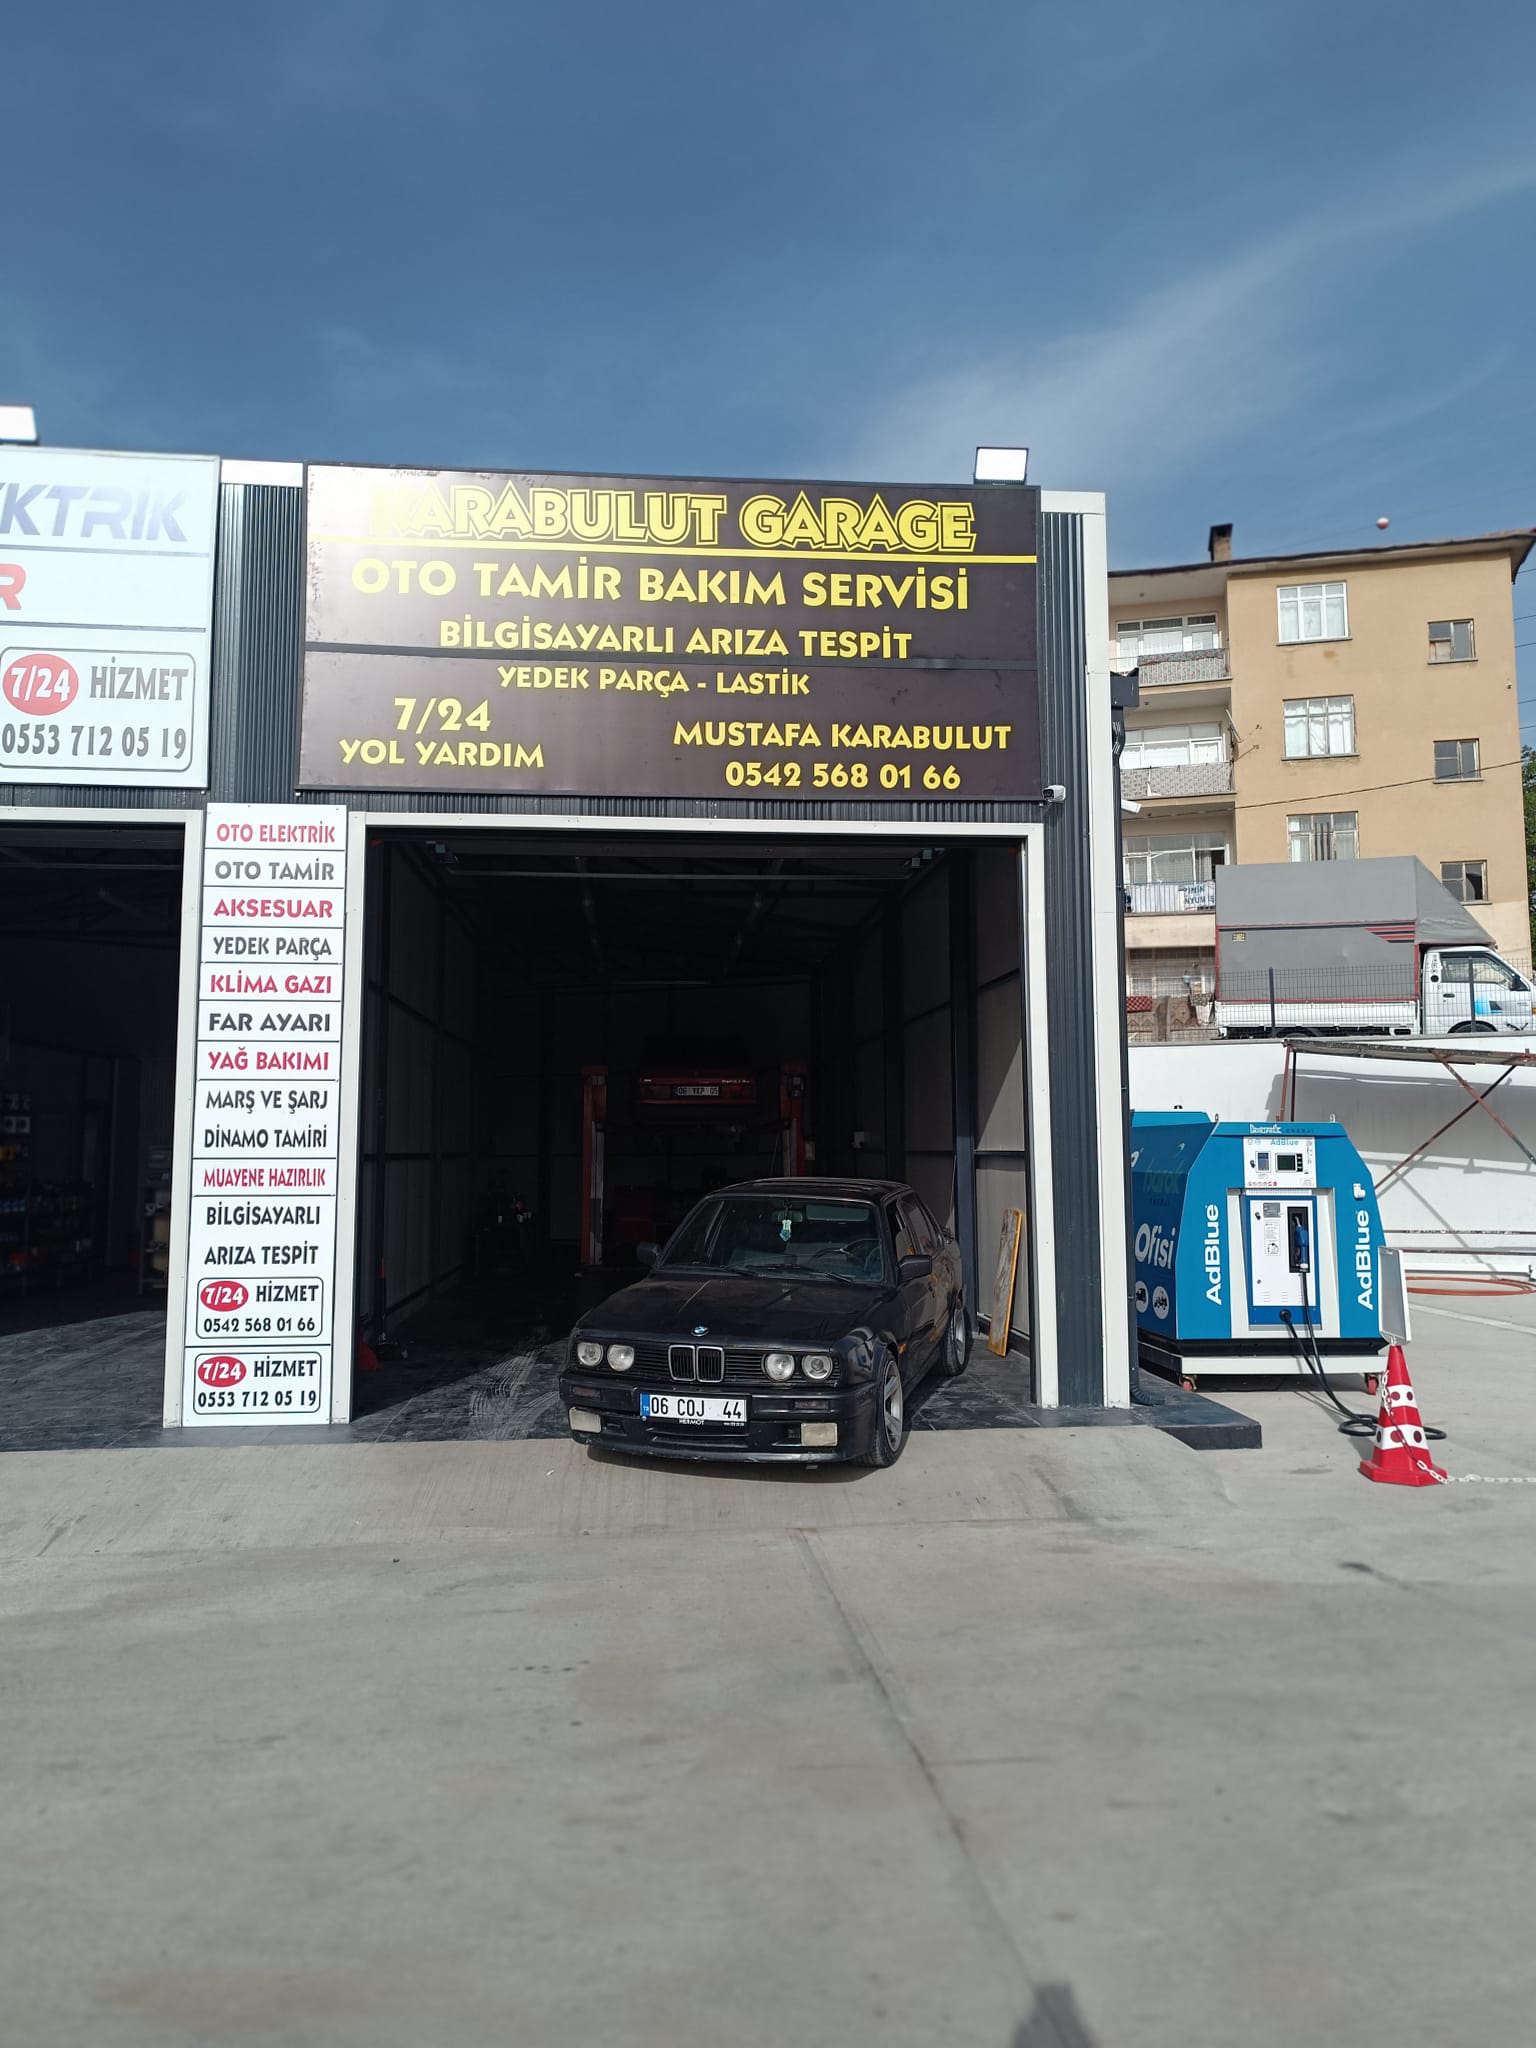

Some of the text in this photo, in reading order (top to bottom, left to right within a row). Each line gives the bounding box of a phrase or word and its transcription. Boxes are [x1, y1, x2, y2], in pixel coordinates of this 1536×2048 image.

[368, 481, 976, 552] KARABULUT GARAGE
[351, 557, 968, 610] OTO TAMİR BAKIM SERVİSİ
[439, 615, 912, 659] BİLGİSAYARLI ARIZA TESPİT
[11, 656, 188, 702] 7/24 HİZMET
[498, 666, 591, 689] YEDEK
[600, 669, 689, 697] PARÇA
[717, 668, 809, 694] LASTİK
[394, 697, 492, 734] 7/24
[1, 723, 186, 759] 0553 712 05 19
[674, 721, 1011, 750] MUSTAFA KARABULUT
[339, 739, 544, 768] YOL YARDIM
[725, 762, 960, 790] 0542 568 01 66
[217, 821, 335, 843] OTO ELEKTRİK
[215, 858, 334, 880] OTO TAMİR
[214, 899, 332, 918] AKSESUAR
[213, 937, 331, 961] YEDEK PARÇA
[211, 970, 331, 993] KLİMA GAZI
[209, 1013, 330, 1032] FAR AYARI
[208, 1047, 328, 1070] YAĞ BAKIMI
[206, 1090, 327, 1114] MARŞ VE ŞARJ
[205, 1124, 326, 1148] DİNAMO TAMİRİ
[204, 1168, 325, 1187] MUAYENE HAZIRLIK
[207, 1201, 320, 1225] BİLGİSAYARLI
[204, 1241, 318, 1265] ARIZA TESPİT
[1134, 1223, 1176, 1269] Ofisi
[1204, 1204, 1222, 1305] AdBlue
[1355, 1210, 1373, 1310] AdBlue
[204, 1281, 319, 1305] 7/24 HİZMET
[204, 1318, 315, 1333] 0542 568 01 66
[202, 1356, 317, 1380] 7/24 HİZMET
[198, 1390, 316, 1407] 0553 712 05 19
[651, 1397, 741, 1418] 06 COJ 44
